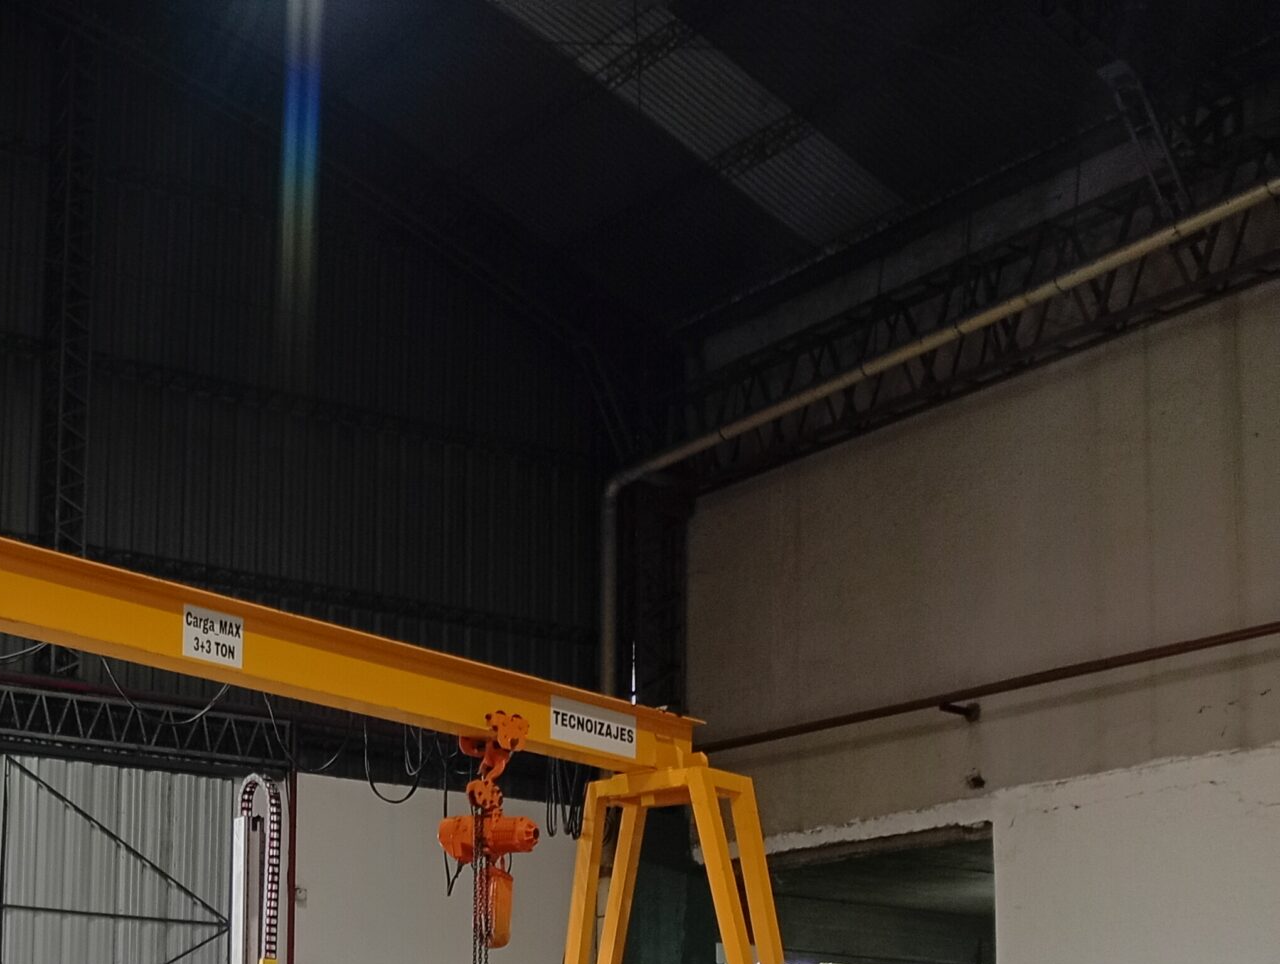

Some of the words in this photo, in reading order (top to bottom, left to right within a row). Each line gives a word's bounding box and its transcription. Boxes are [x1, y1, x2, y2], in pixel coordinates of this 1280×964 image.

[193, 636, 211, 655] 3+3
[214, 641, 235, 660] TON
[552, 709, 634, 744] TECNOIZAJES
